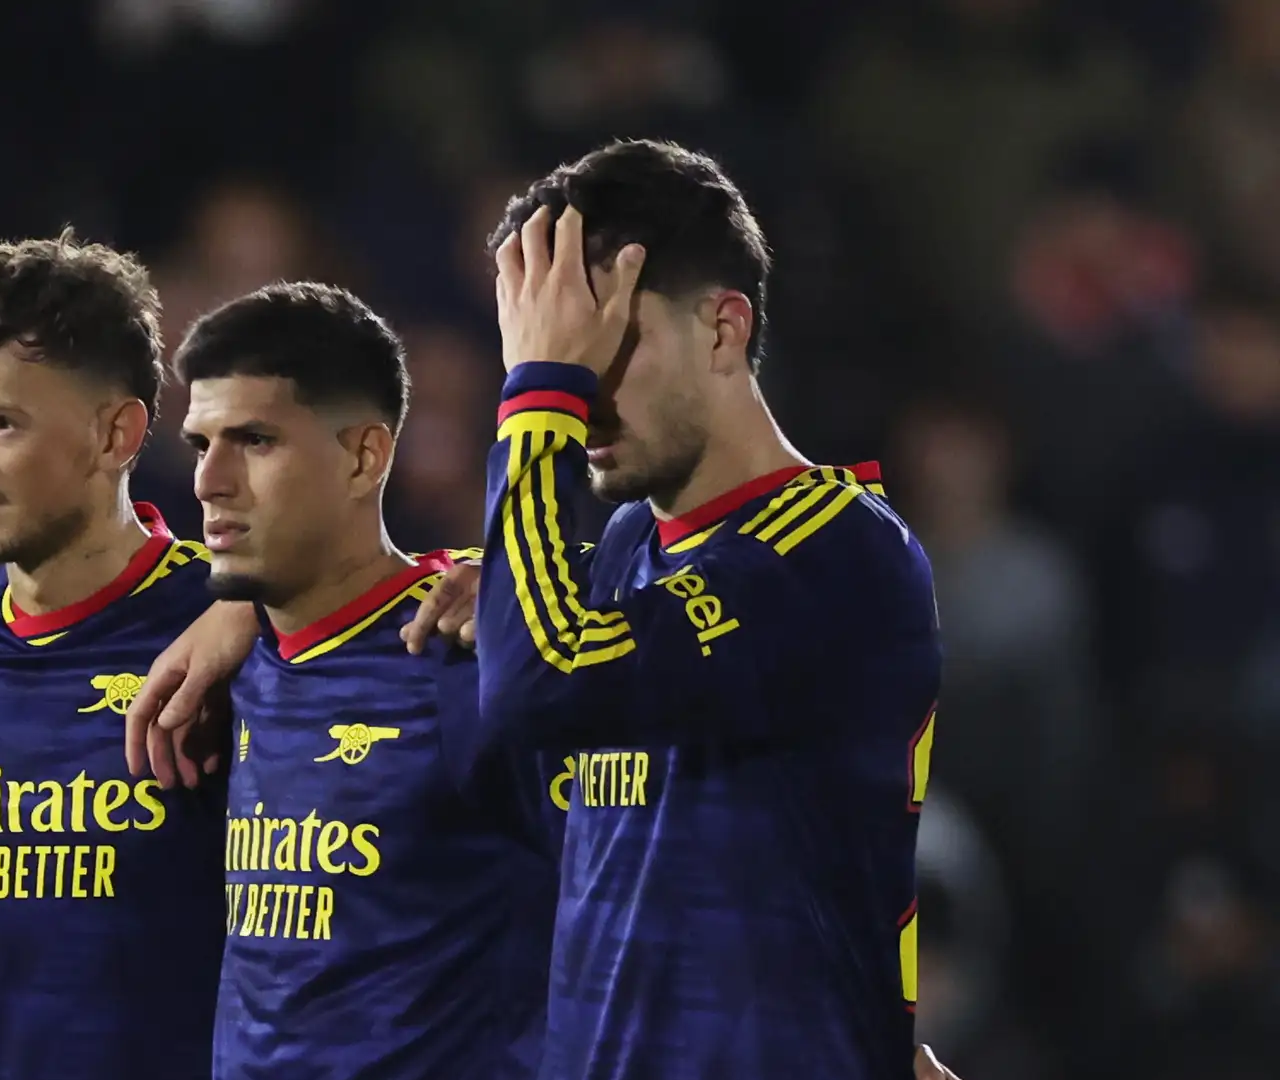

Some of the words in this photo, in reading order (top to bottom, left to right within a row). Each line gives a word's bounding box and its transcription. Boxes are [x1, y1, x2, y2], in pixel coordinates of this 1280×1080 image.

[655, 564, 740, 657] eel.
[225, 801, 382, 876] mirates
[239, 883, 335, 940] BETTER
